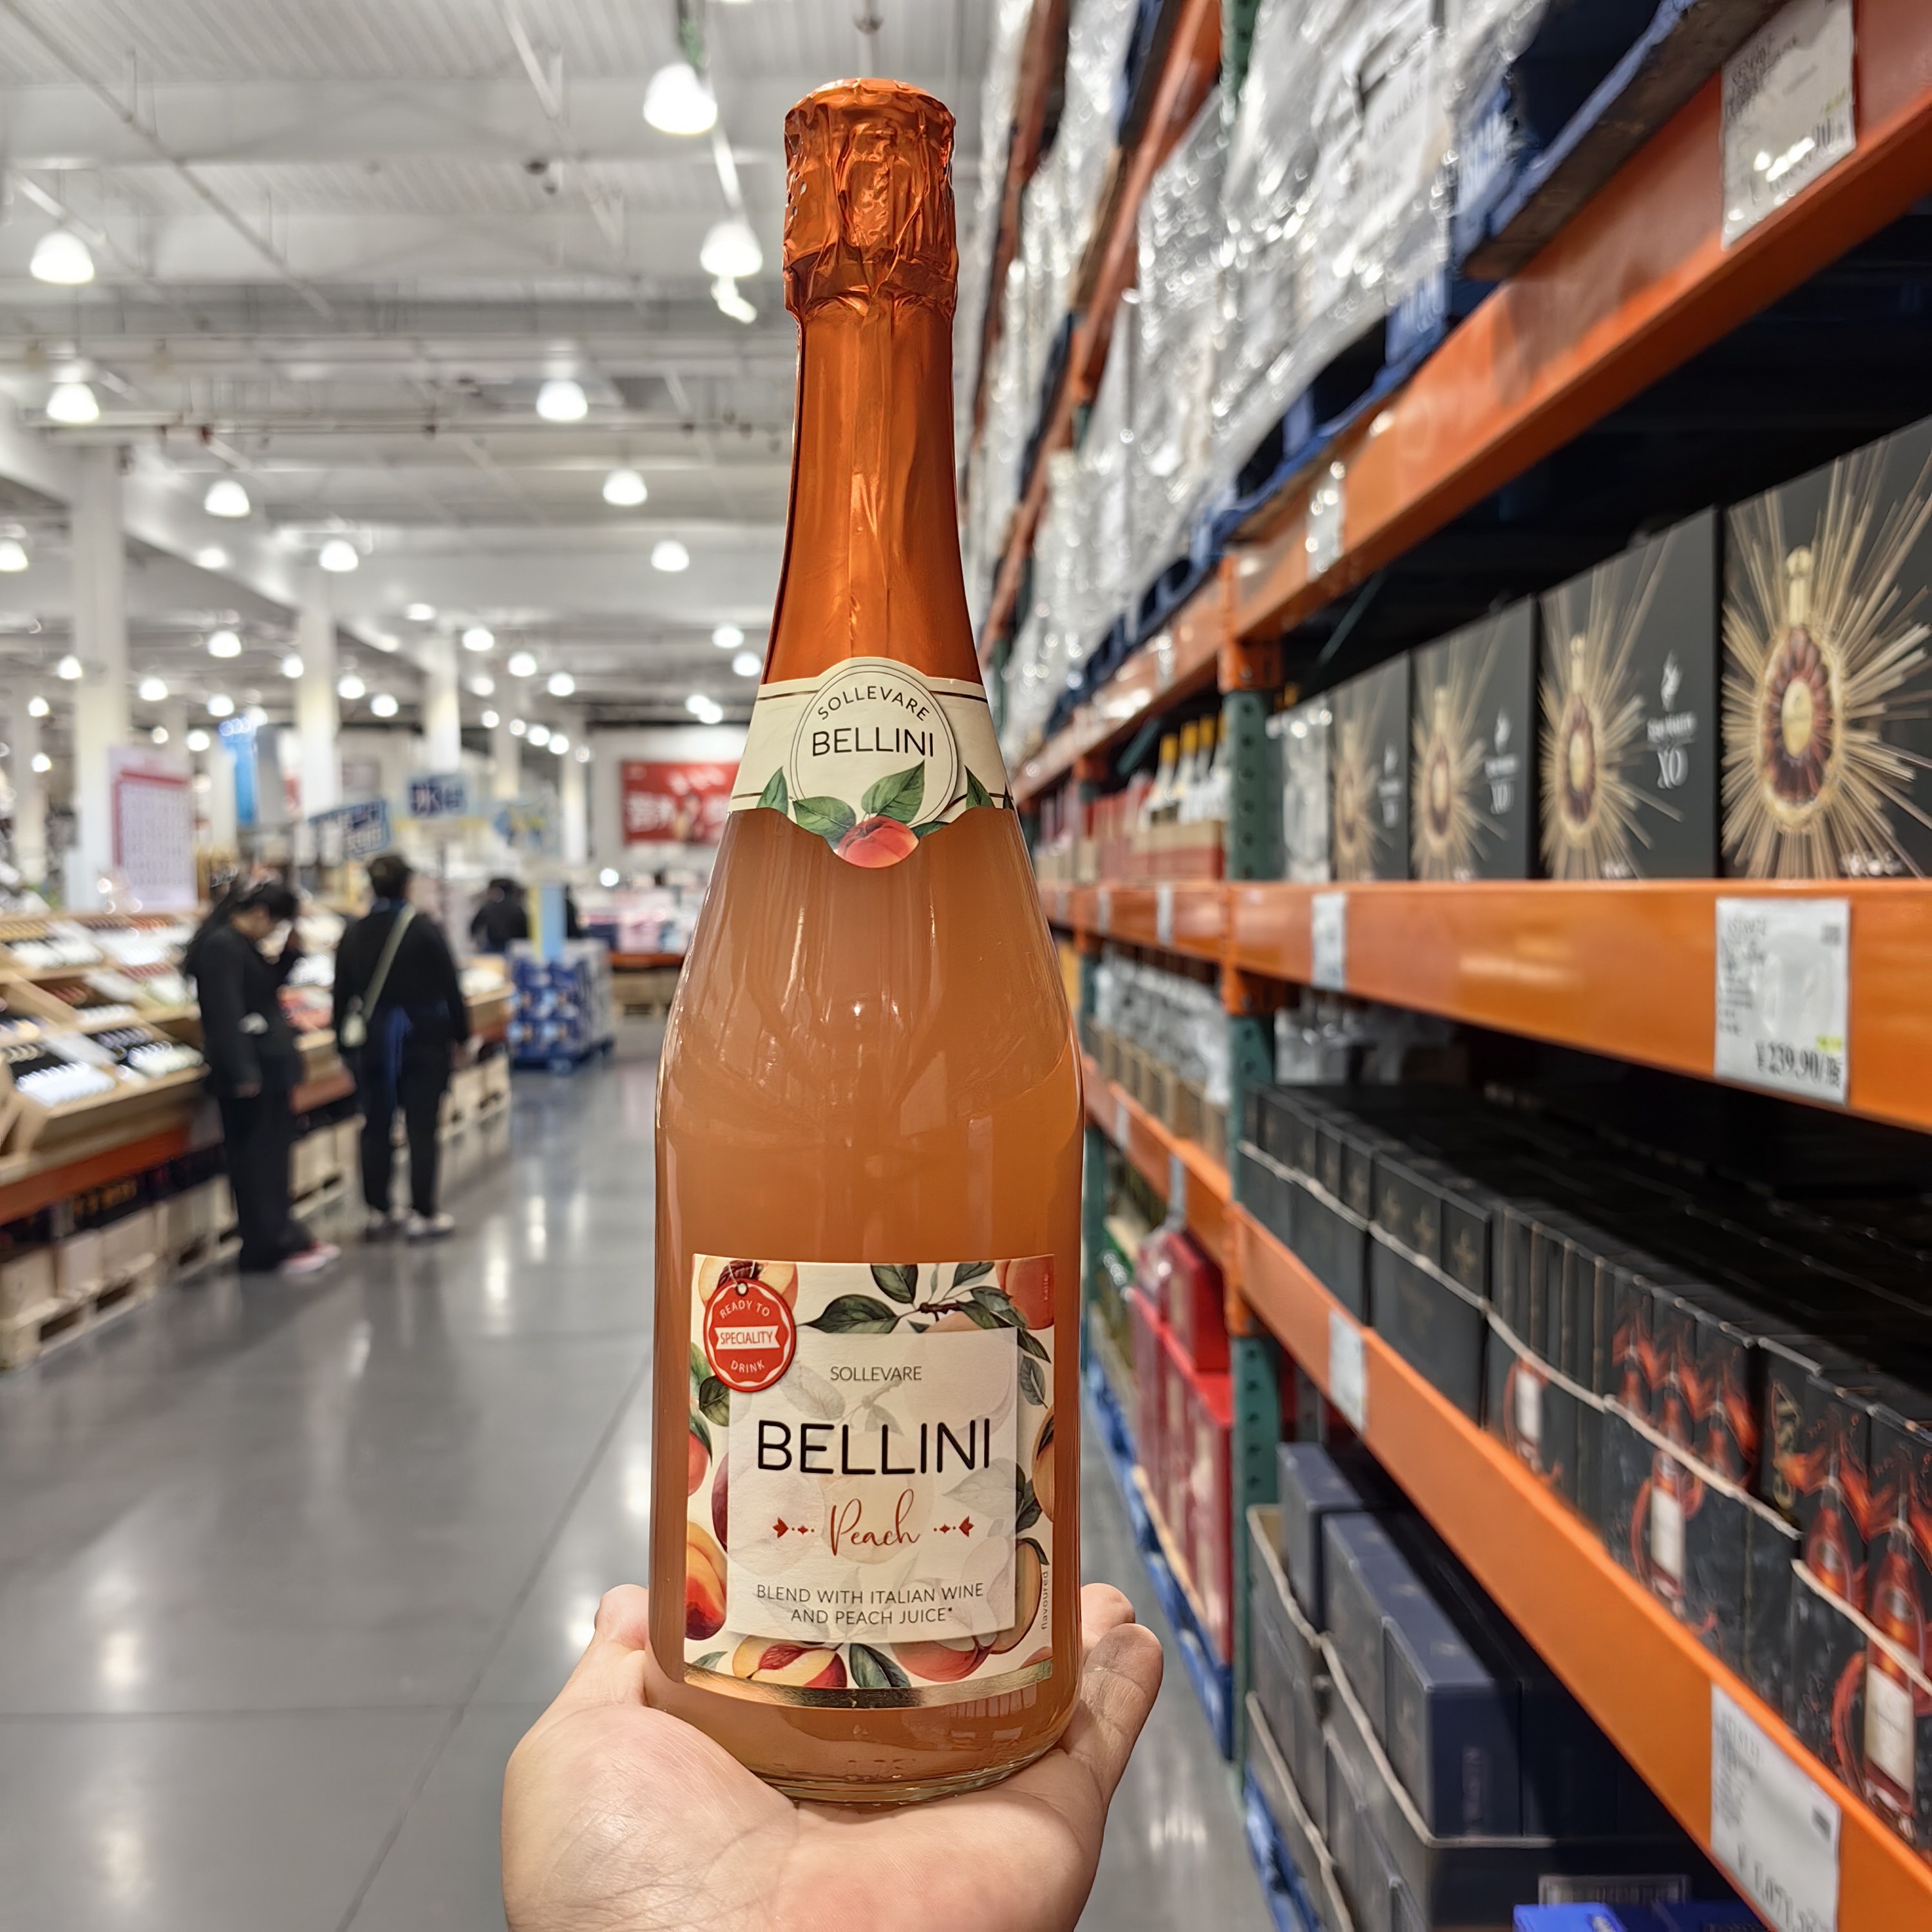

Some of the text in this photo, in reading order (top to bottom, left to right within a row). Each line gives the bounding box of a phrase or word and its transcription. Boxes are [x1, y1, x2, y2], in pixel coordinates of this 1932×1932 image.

[818, 686, 929, 721] SOLLEVARE
[812, 727, 934, 757] BELLINI
[719, 1300, 770, 1319] READY TO
[720, 1330, 773, 1345] SPECIALITY
[730, 1359, 764, 1374] DRINK
[829, 1365, 922, 1381] SOLLEVARE
[757, 1418, 990, 1475] BELLINI
[829, 1488, 921, 1556] Peach
[757, 1582, 984, 1604] BLEND WITH ITALIAN WINE
[1040, 1570, 1049, 1630] flavoured
[790, 1607, 828, 1624] AND
[835, 1610, 893, 1625] PEACH
